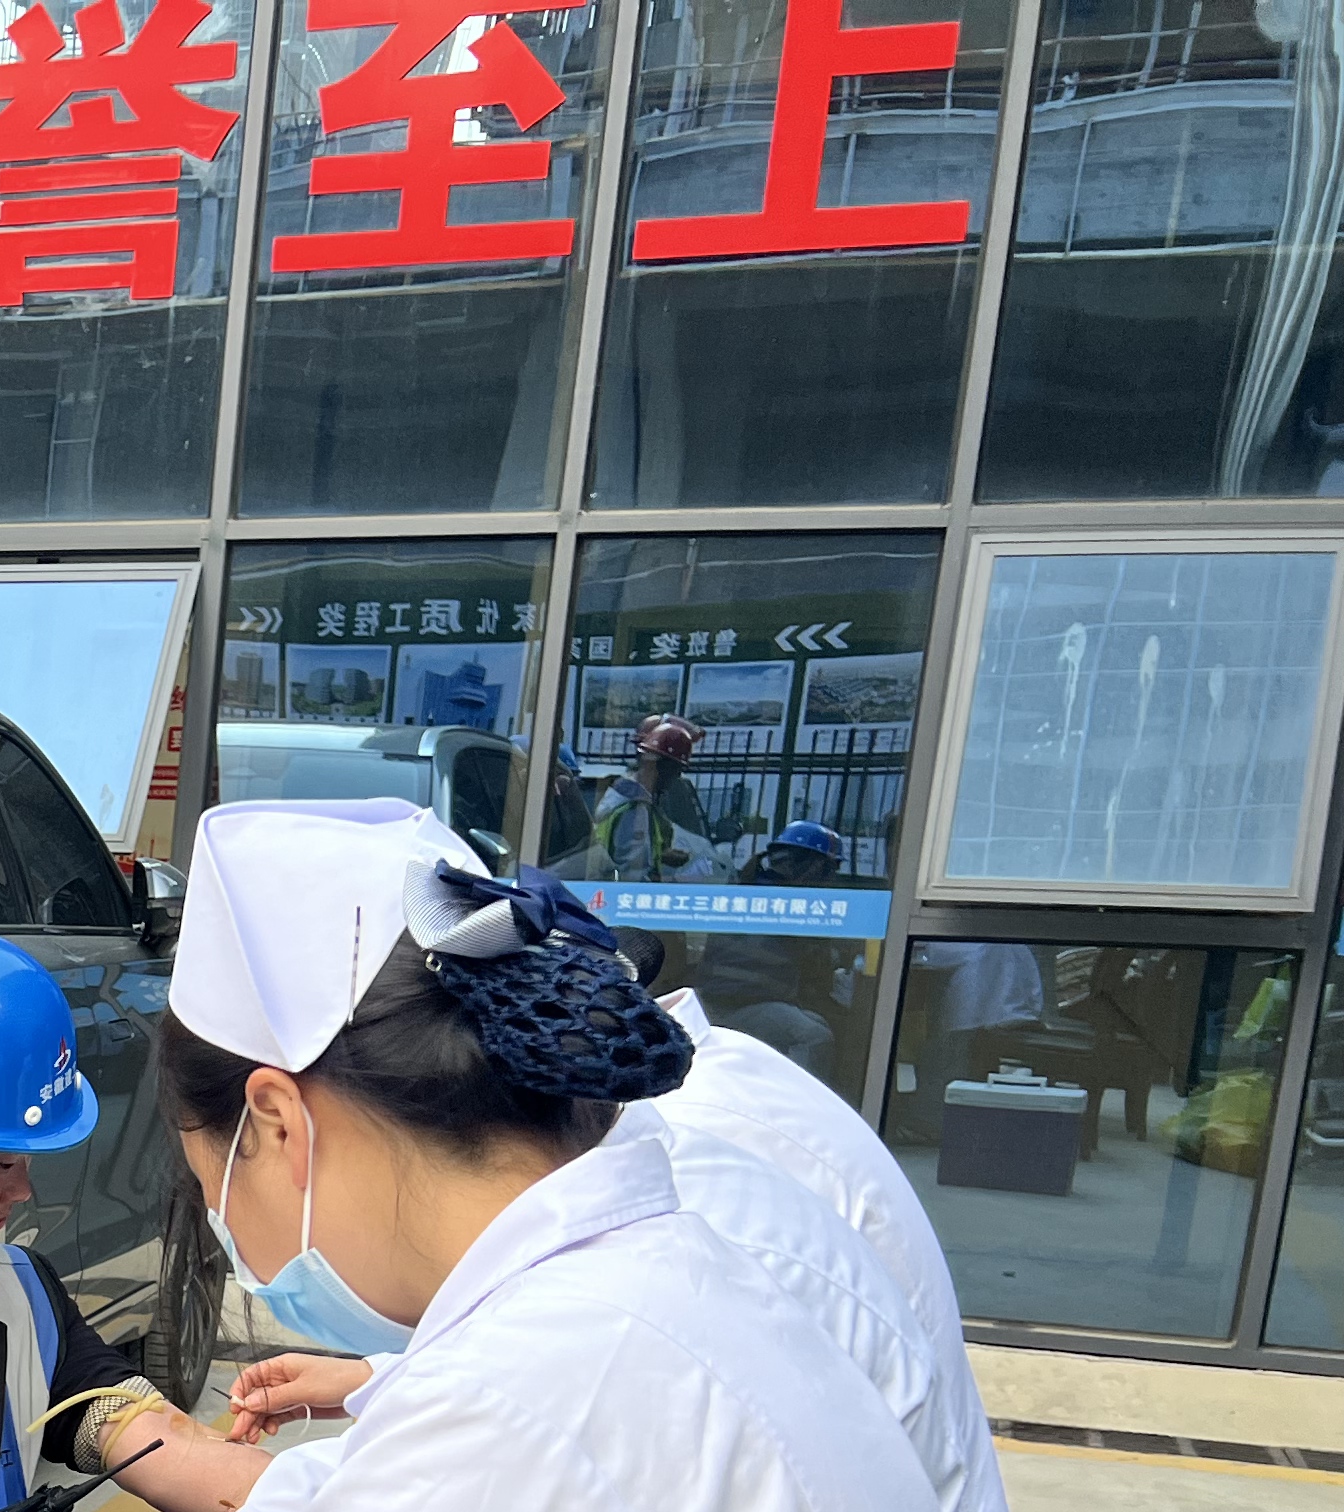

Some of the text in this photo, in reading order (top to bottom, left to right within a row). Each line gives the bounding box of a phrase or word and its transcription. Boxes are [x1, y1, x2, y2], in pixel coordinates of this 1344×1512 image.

[617, 892, 848, 918] 安徽建工三建集团有限公司
